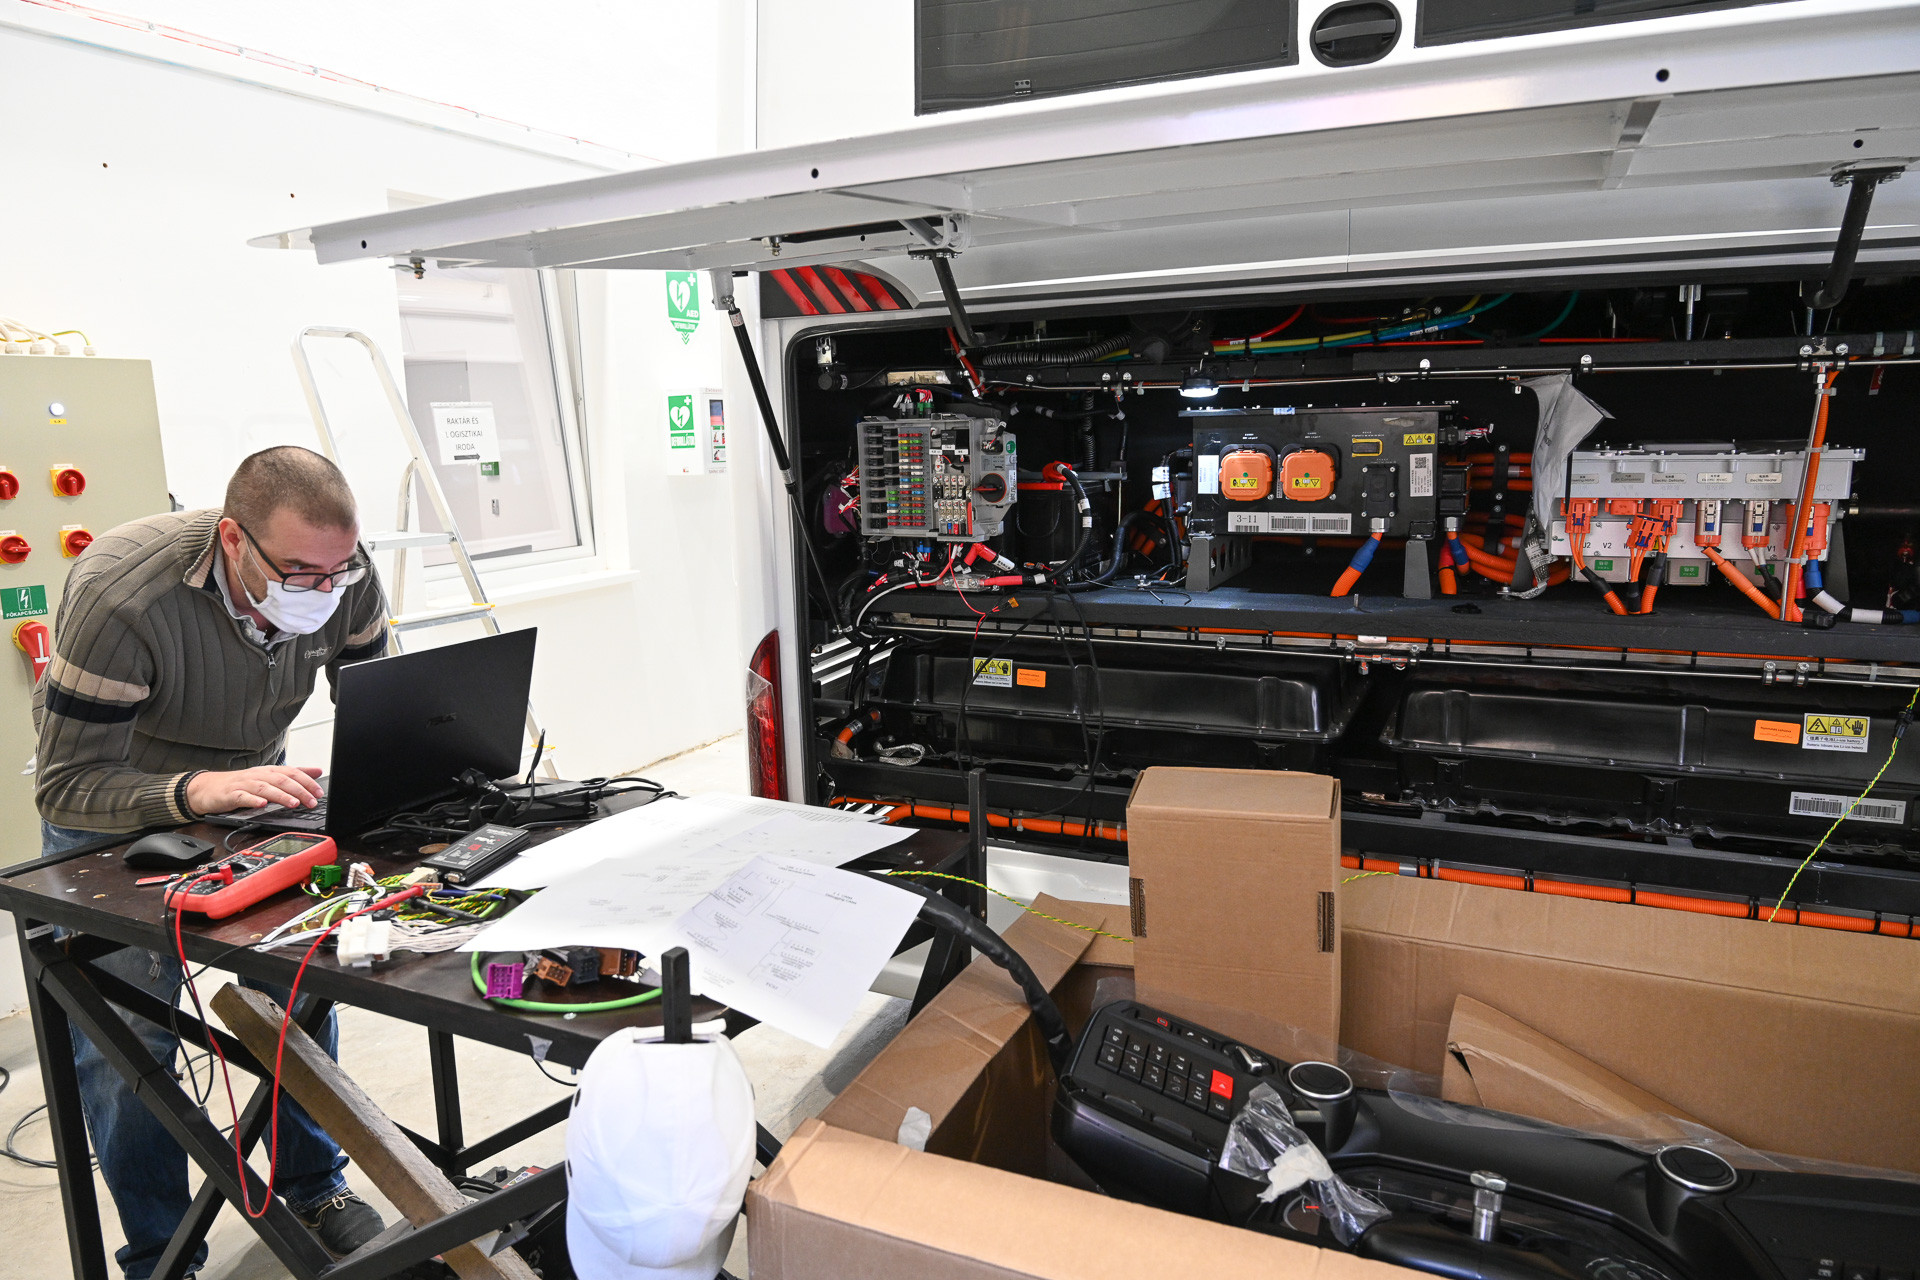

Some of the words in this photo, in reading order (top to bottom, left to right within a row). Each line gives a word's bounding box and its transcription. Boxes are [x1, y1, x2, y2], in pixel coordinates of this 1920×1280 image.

[686, 309, 699, 318] AED
[446, 416, 470, 425] RAKTÁR
[471, 416, 479, 425] ÉS
[445, 430, 483, 438] LOGISZTIKAI
[455, 443, 476, 451] IRODA
[1236, 514, 1257, 523] 3-11
